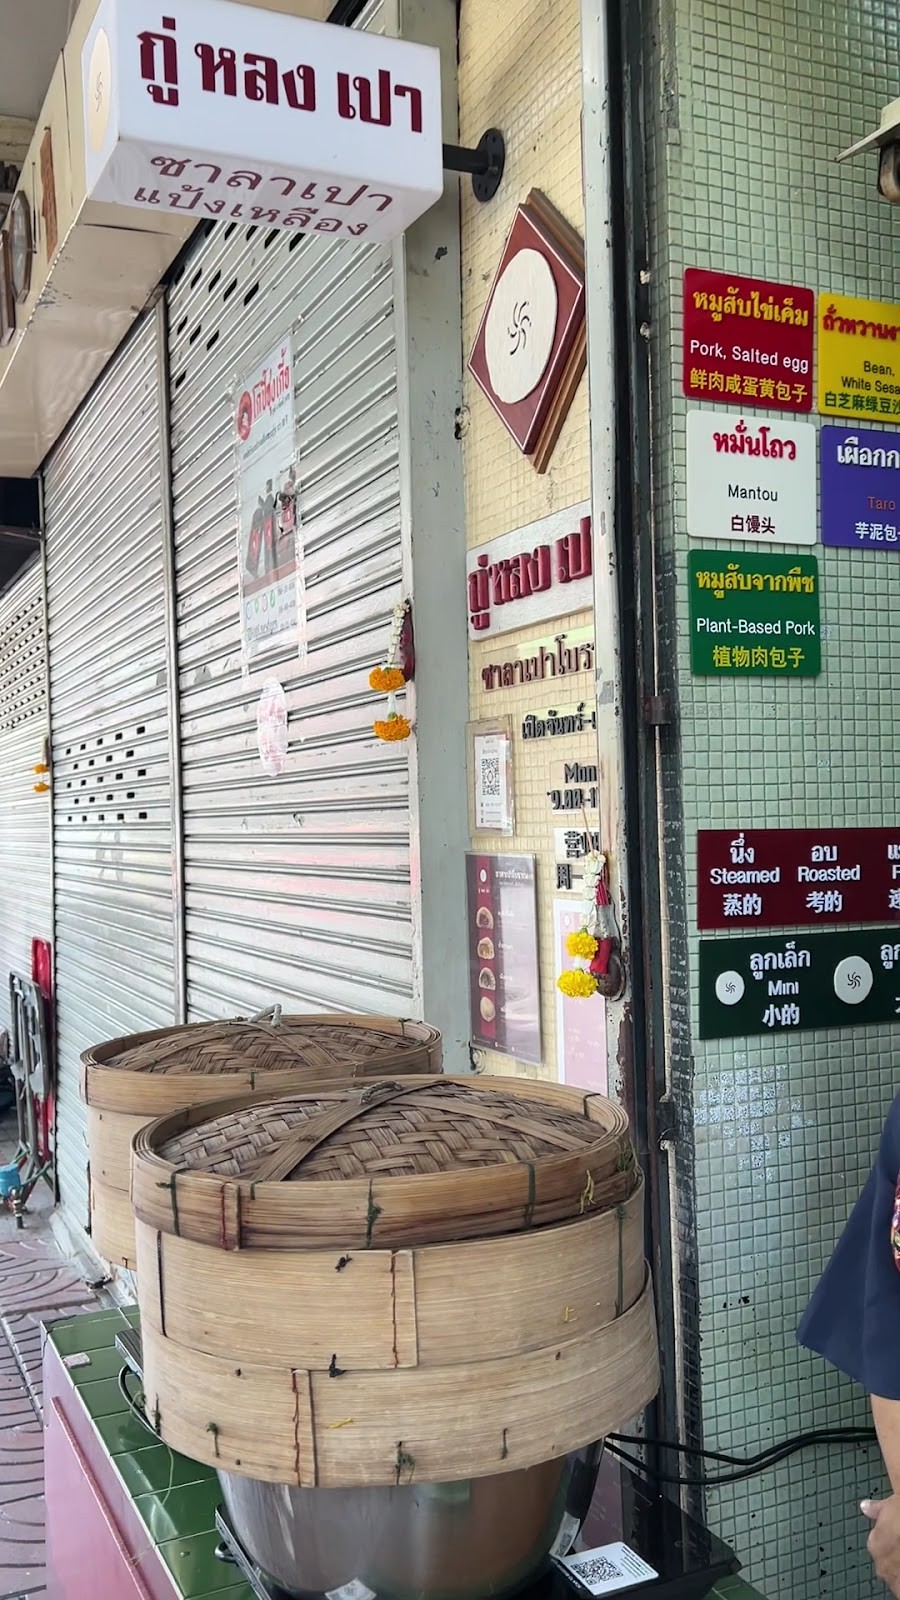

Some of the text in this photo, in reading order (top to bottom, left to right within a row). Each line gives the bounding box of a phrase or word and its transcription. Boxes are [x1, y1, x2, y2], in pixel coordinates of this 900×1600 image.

[337, 69, 422, 133] เปา
[150, 156, 393, 212] ซาลาเปา
[134, 184, 369, 236] แป้งเหลือง
[693, 286, 809, 327] หมูสับไข่เค็ม
[690, 340, 809, 373] Pork, Salted egg
[690, 367, 808, 403] 鲜肉咸蛋黄包子
[841, 376, 871, 391] White
[713, 420, 796, 460] หมั่นโถว
[728, 484, 778, 502] Mantou
[867, 496, 896, 510] Taro
[731, 515, 775, 535] 白馒头
[855, 521, 900, 541] 芋泥包
[696, 563, 814, 599] หมูสับจากพืช
[696, 618, 816, 635] Plant-Based Pork
[481, 634, 595, 691] ซาลาเปาโบร
[713, 645, 805, 668] 植物肉包子
[730, 832, 755, 864] นึ่ง
[811, 845, 838, 862] อบ
[710, 867, 780, 884] Steamed
[798, 865, 861, 882] Roasted
[723, 893, 762, 916] 蒸的
[806, 890, 843, 914] 考的
[750, 941, 811, 980] ลูกเล็ก
[768, 980, 799, 997] Mini
[762, 1003, 800, 1028] 小的
